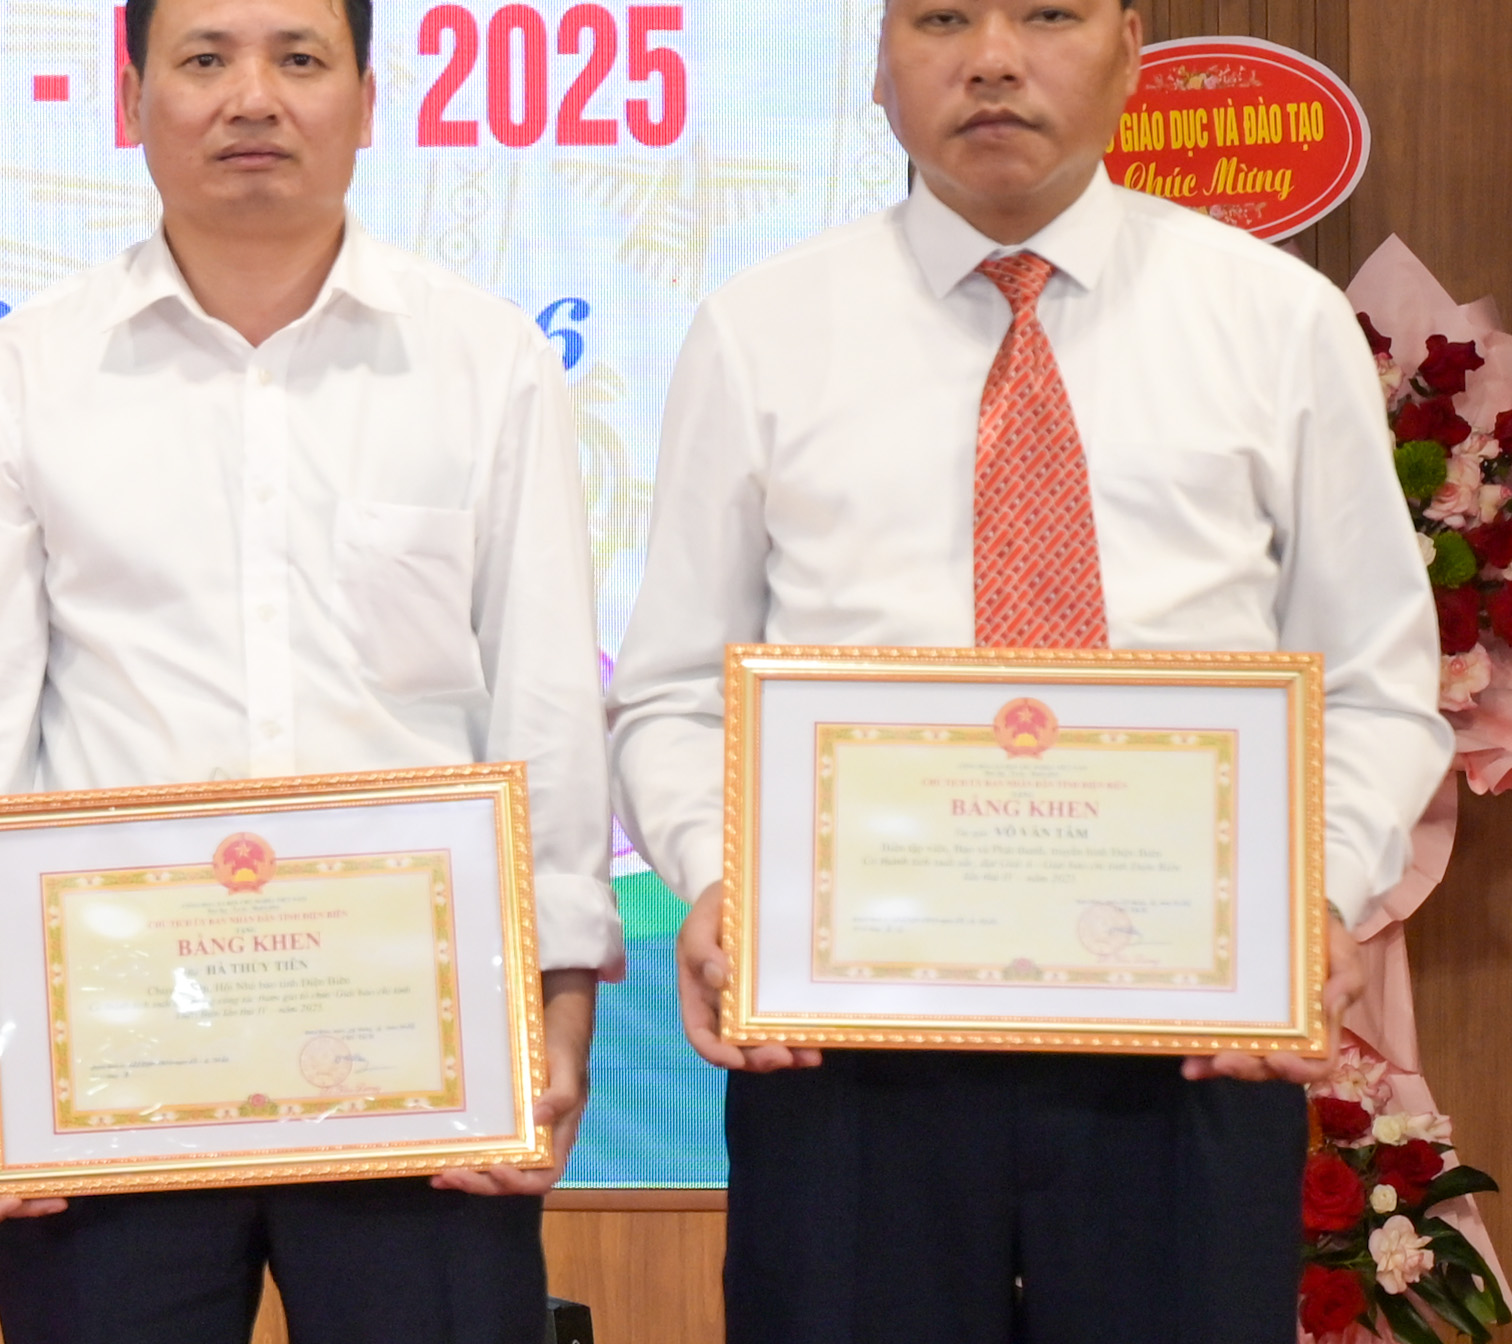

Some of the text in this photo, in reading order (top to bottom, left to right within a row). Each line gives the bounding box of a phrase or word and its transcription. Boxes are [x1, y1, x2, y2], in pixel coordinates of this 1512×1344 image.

[416, 2, 688, 148] 2025
[1120, 104, 1165, 153] GIÁO
[1170, 108, 1208, 157] DỤC
[1214, 98, 1239, 147] VÀ
[1243, 97, 1282, 145] ĐÀO
[1287, 101, 1324, 151] TẠO
[1124, 156, 1294, 200] Chúc Mừng
[952, 794, 1099, 818] BẰNG KHEN
[178, 931, 321, 957] BẰNG KHEN
